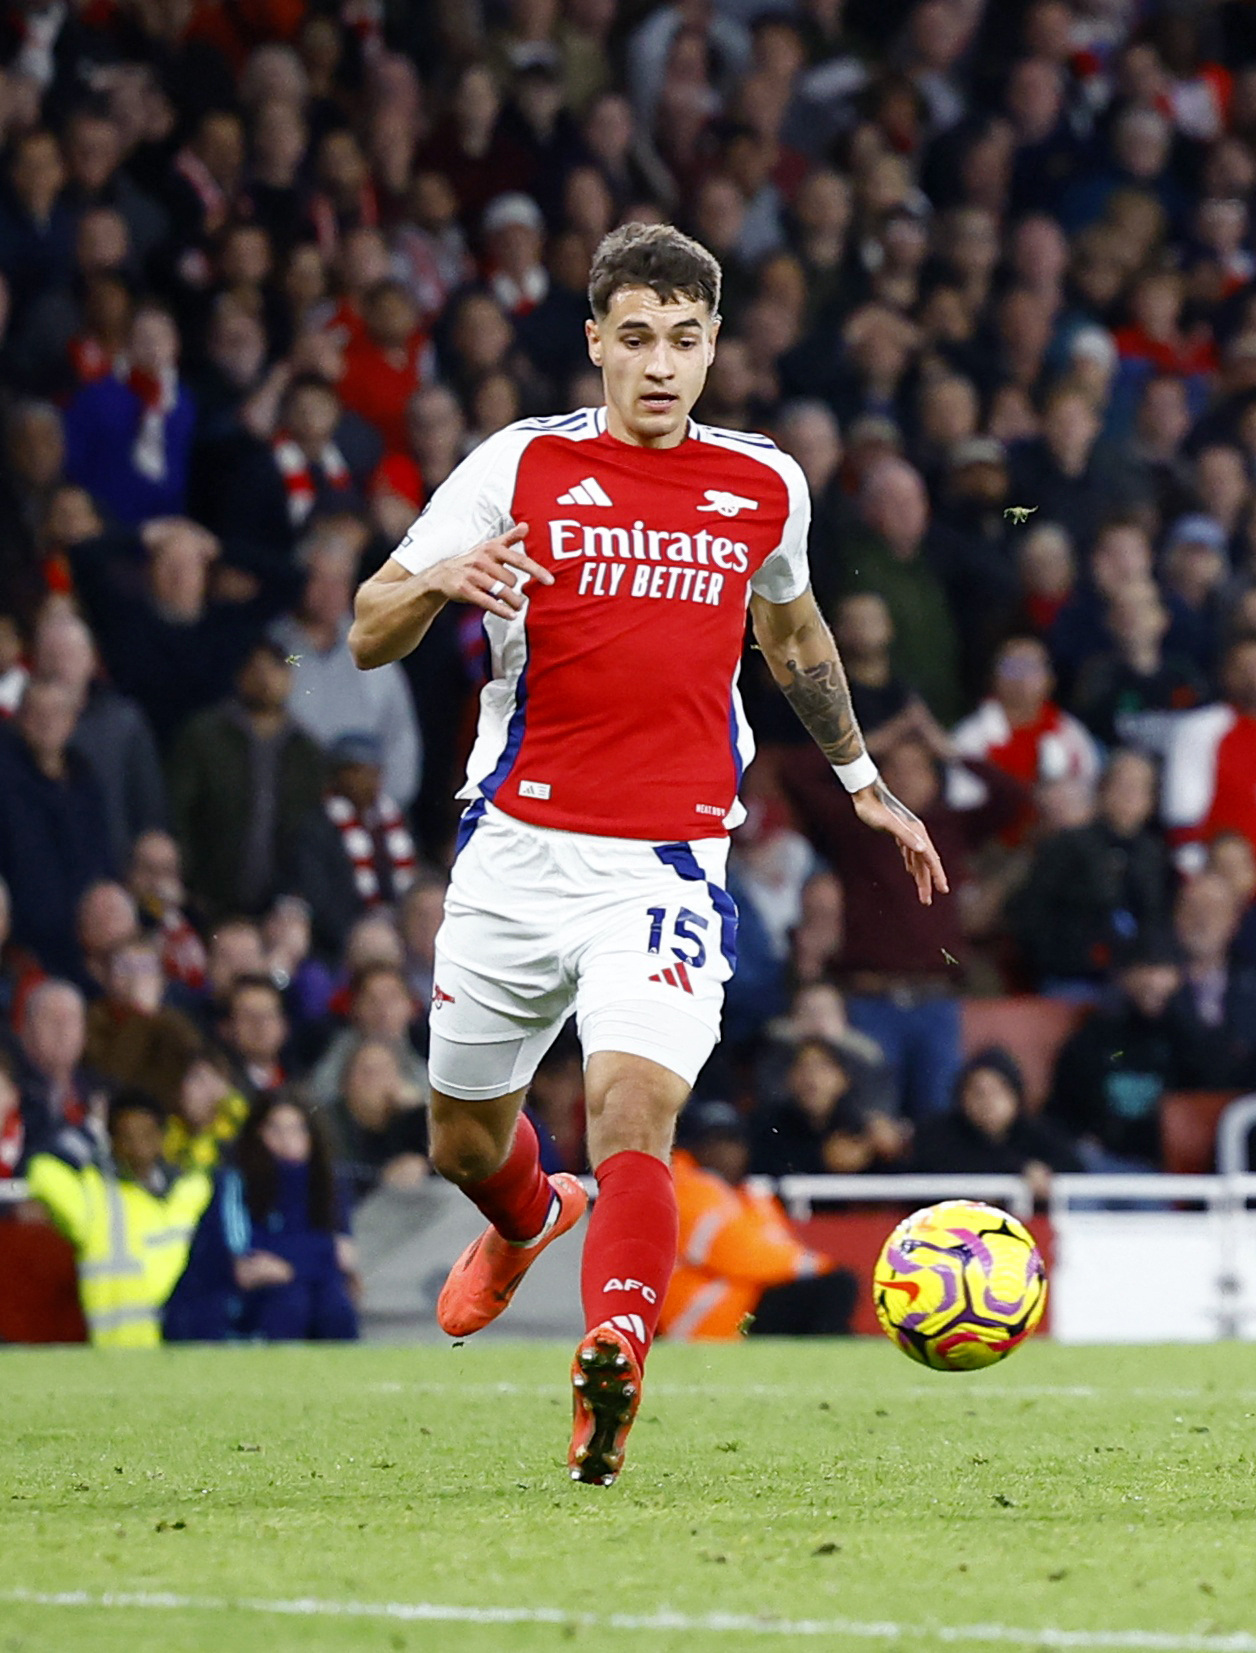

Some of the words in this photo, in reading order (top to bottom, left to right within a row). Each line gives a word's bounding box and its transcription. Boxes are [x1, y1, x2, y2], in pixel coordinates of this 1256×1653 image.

[548, 520, 749, 573] Emirates
[578, 561, 626, 596] FLY
[631, 564, 724, 606] BETTER
[646, 906, 709, 969] 15
[603, 1277, 657, 1305] AFC
